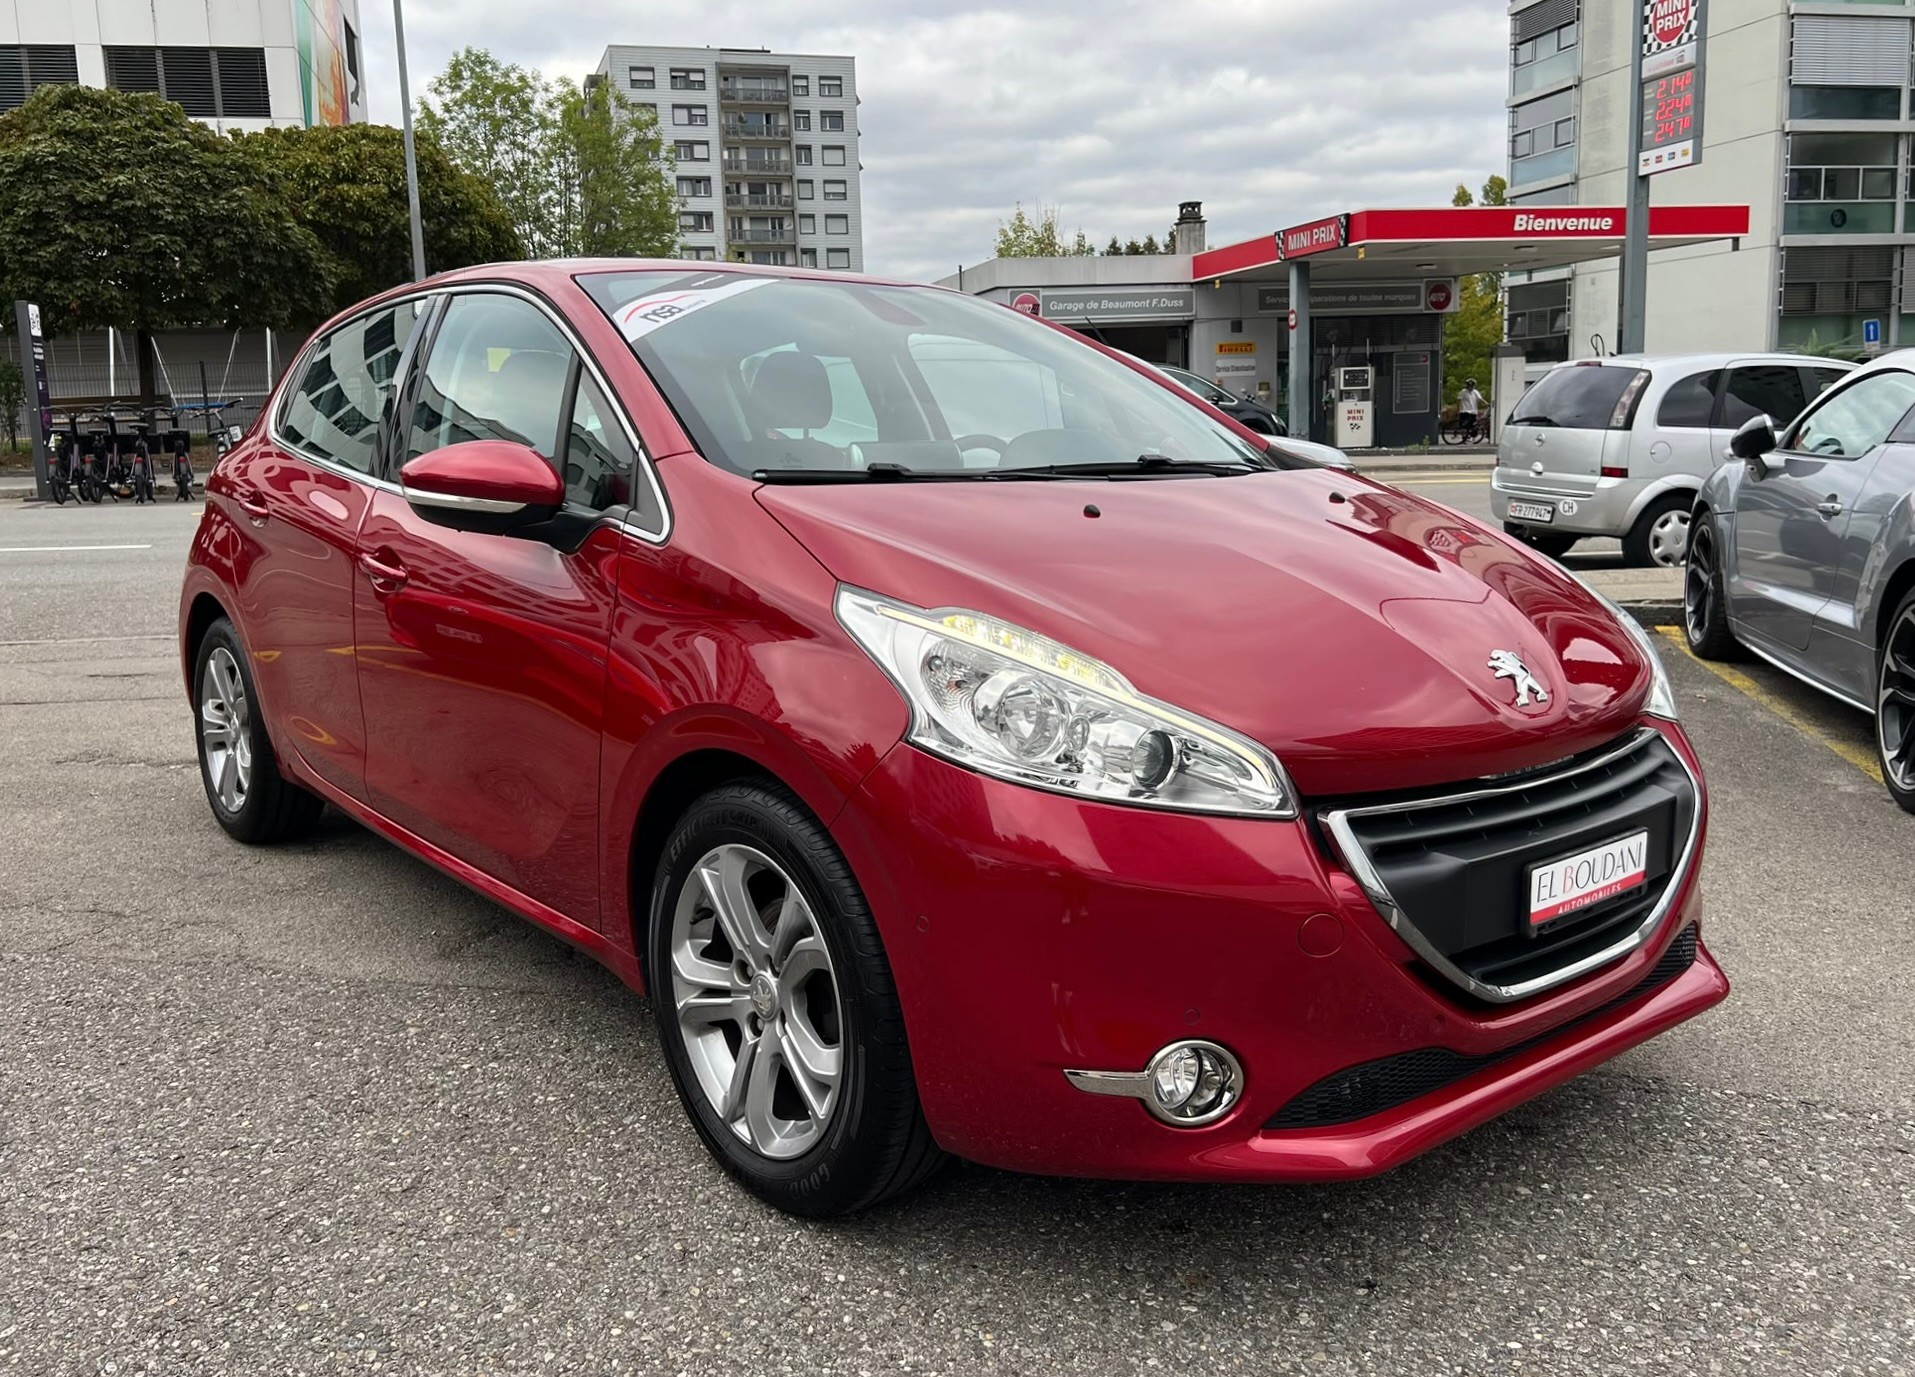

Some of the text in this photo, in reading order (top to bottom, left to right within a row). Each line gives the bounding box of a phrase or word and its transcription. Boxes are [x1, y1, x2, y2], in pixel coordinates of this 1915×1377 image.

[1655, 10, 1686, 35] PRIX
[1513, 214, 1613, 231] Bienvenue
[1288, 223, 1336, 251] MINI PRIX
[1050, 298, 1184, 313] Garage de Beaumont F.Duss
[1265, 295, 1289, 304] Servic
[639, 304, 685, 323] nsa
[1562, 501, 1574, 513] CH
[1537, 841, 1643, 903] EL BOUDANI
[1558, 883, 1621, 915] AUTOMOBILES
